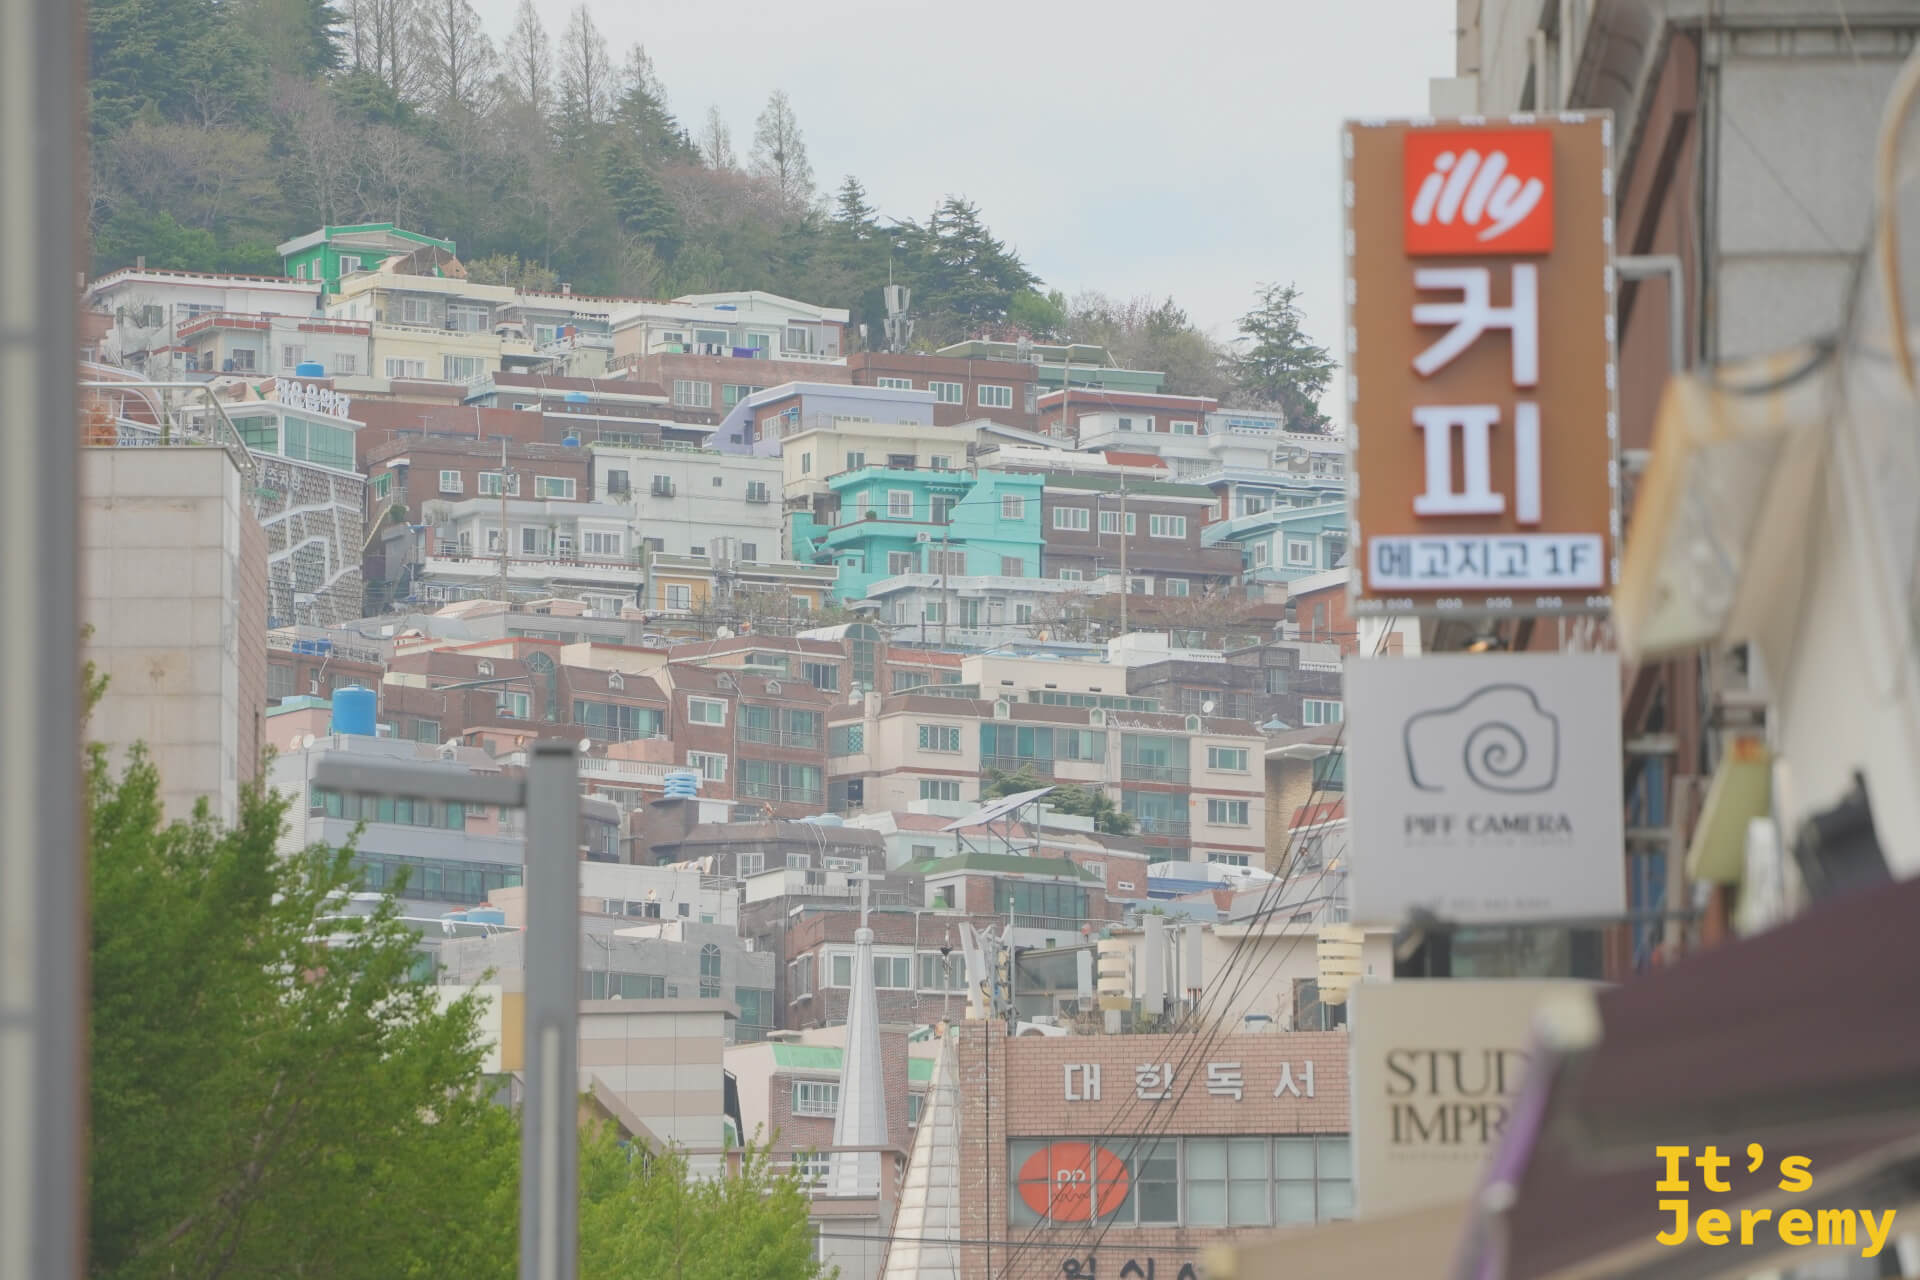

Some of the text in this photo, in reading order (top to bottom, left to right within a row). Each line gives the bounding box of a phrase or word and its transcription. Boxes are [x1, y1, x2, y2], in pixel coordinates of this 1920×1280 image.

[1411, 148, 1544, 242] illy
[1411, 264, 1541, 524] 커피
[1544, 543, 1592, 576] 1F
[1466, 814, 1574, 835] CAMERA
